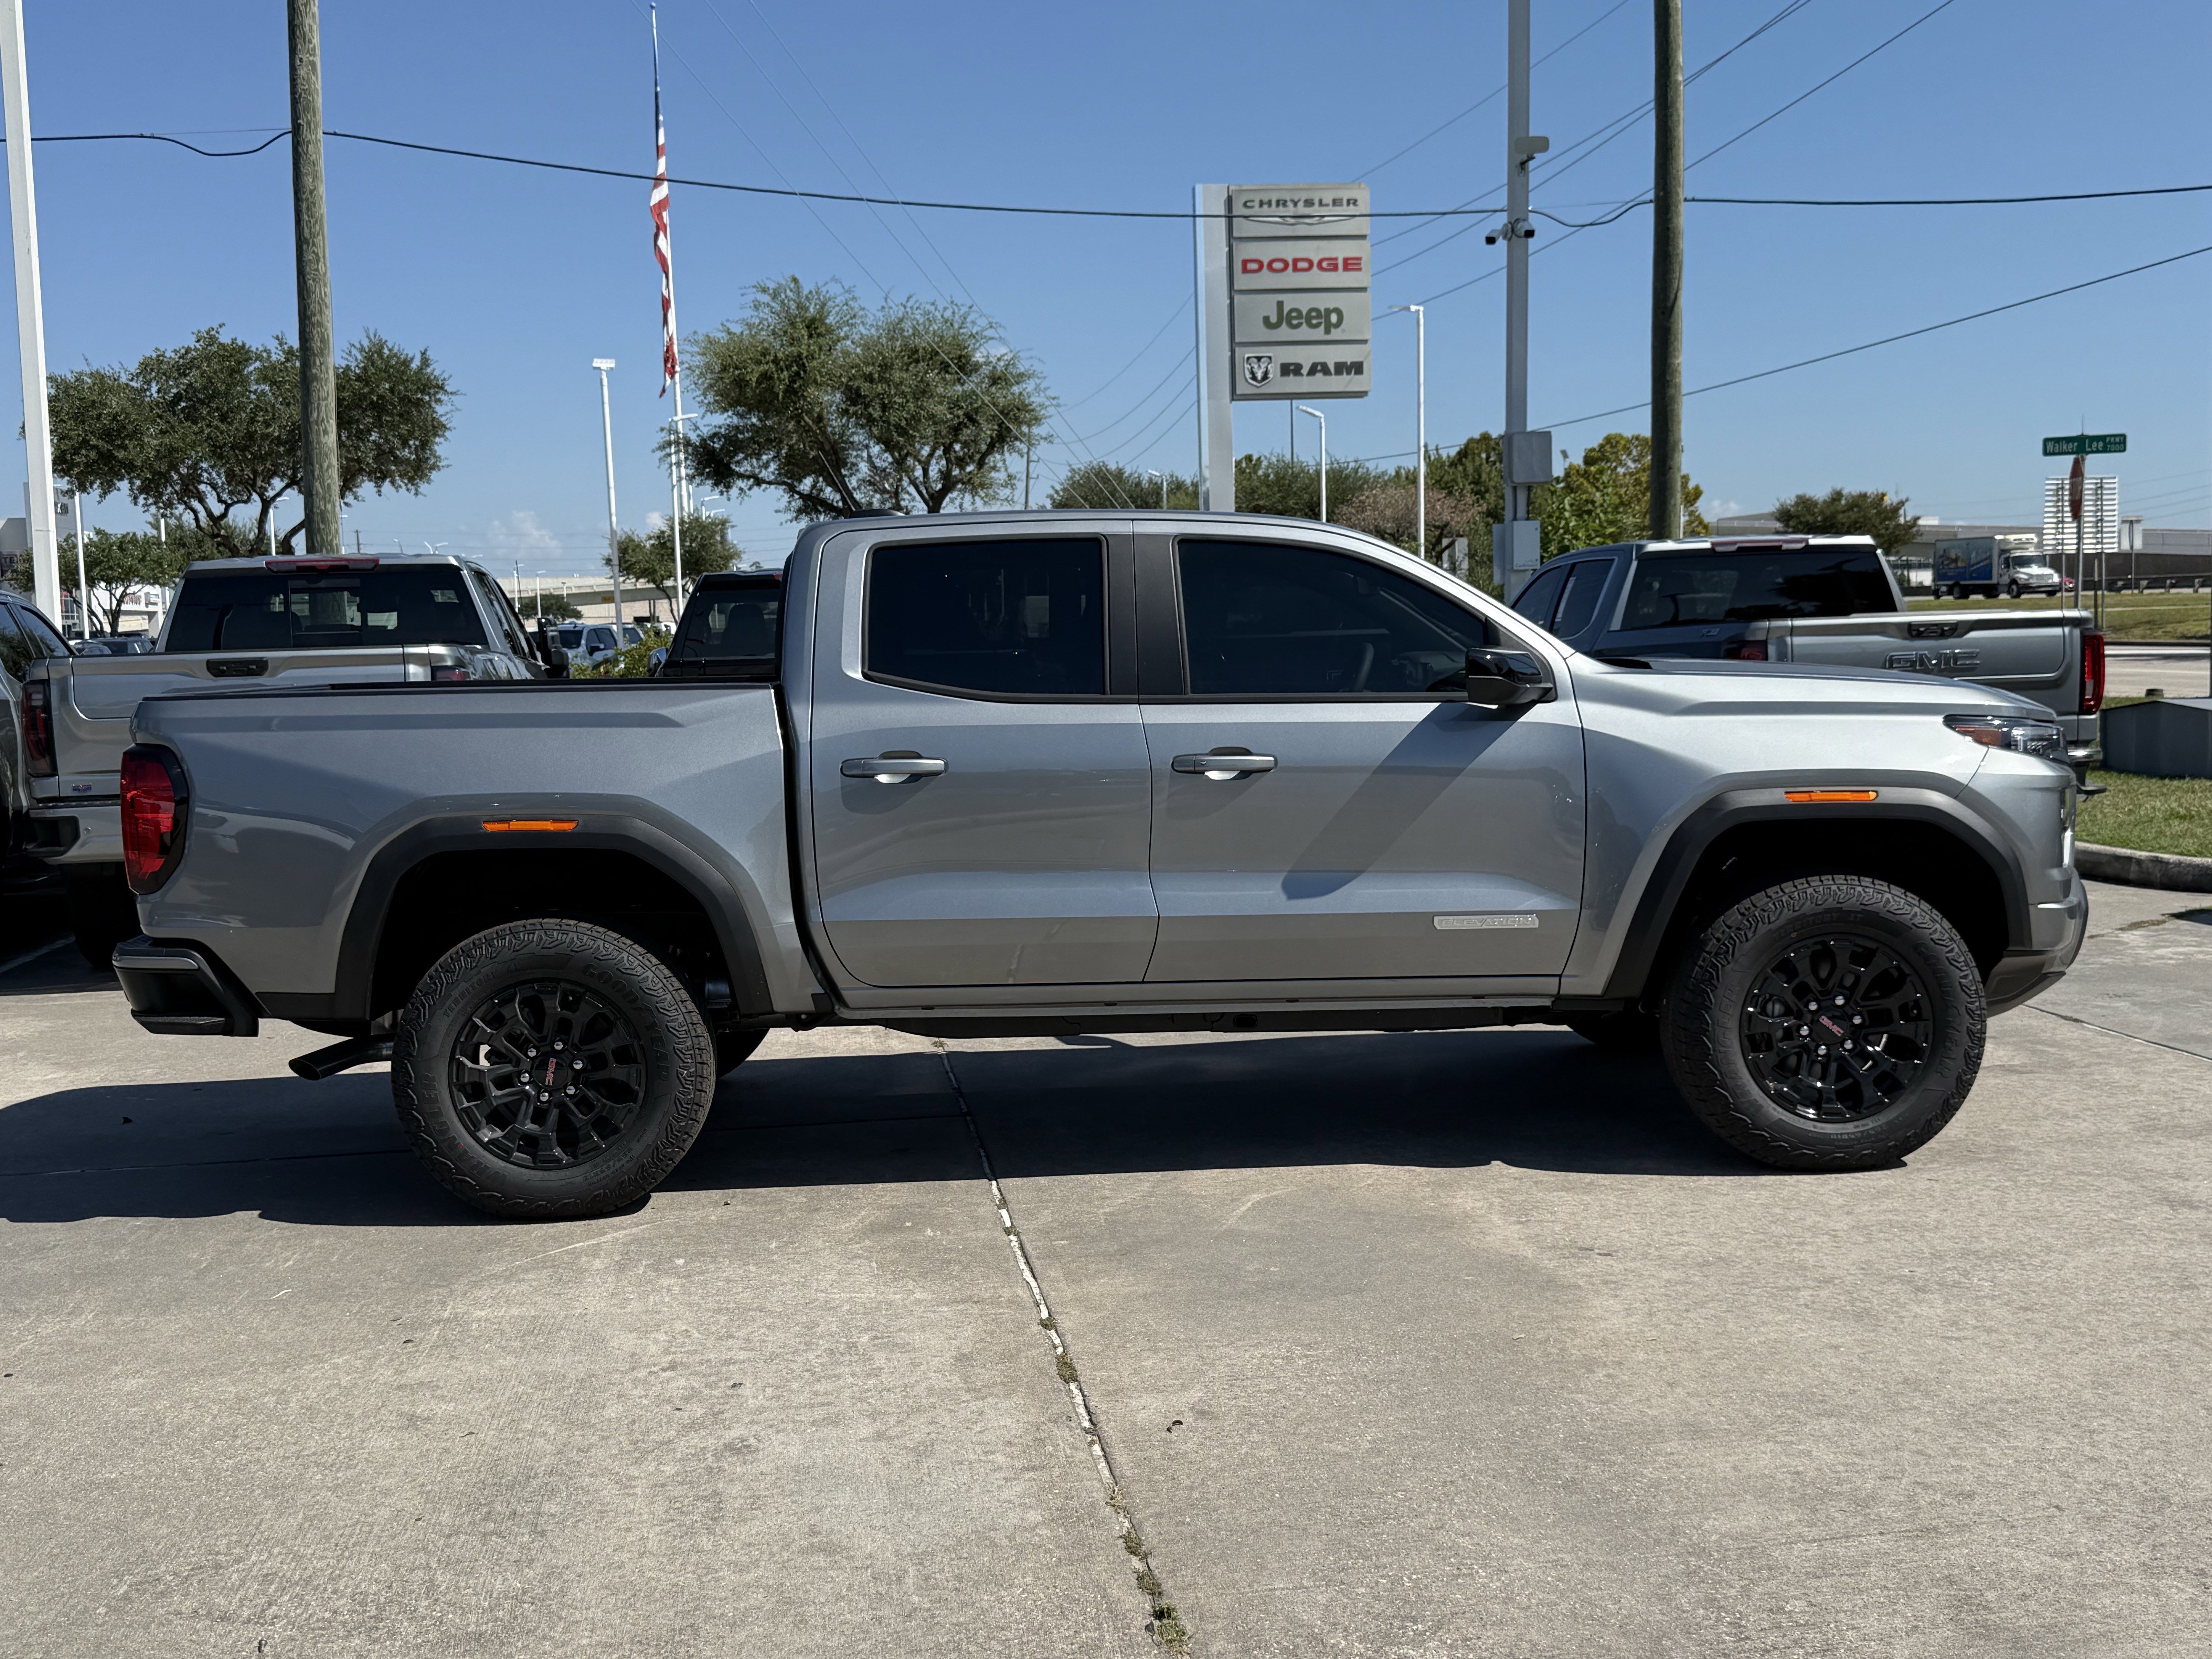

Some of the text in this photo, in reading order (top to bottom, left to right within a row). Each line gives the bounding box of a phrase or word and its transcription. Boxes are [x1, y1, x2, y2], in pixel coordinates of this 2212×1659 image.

[1242, 198, 1359, 209] CHRYSLER
[1241, 256, 1362, 274] DODGE
[1262, 300, 1344, 335] Jeep
[1279, 361, 1364, 378] RAM
[2046, 440, 2078, 453] Walker
[2085, 439, 2104, 451] Lee
[1886, 649, 1980, 672] GMC
[1442, 918, 1532, 927] ELEVATION
[582, 962, 670, 1081] GOODYEAR
[1819, 1015, 1844, 1036] GMC
[545, 1058, 556, 1086] GMC
